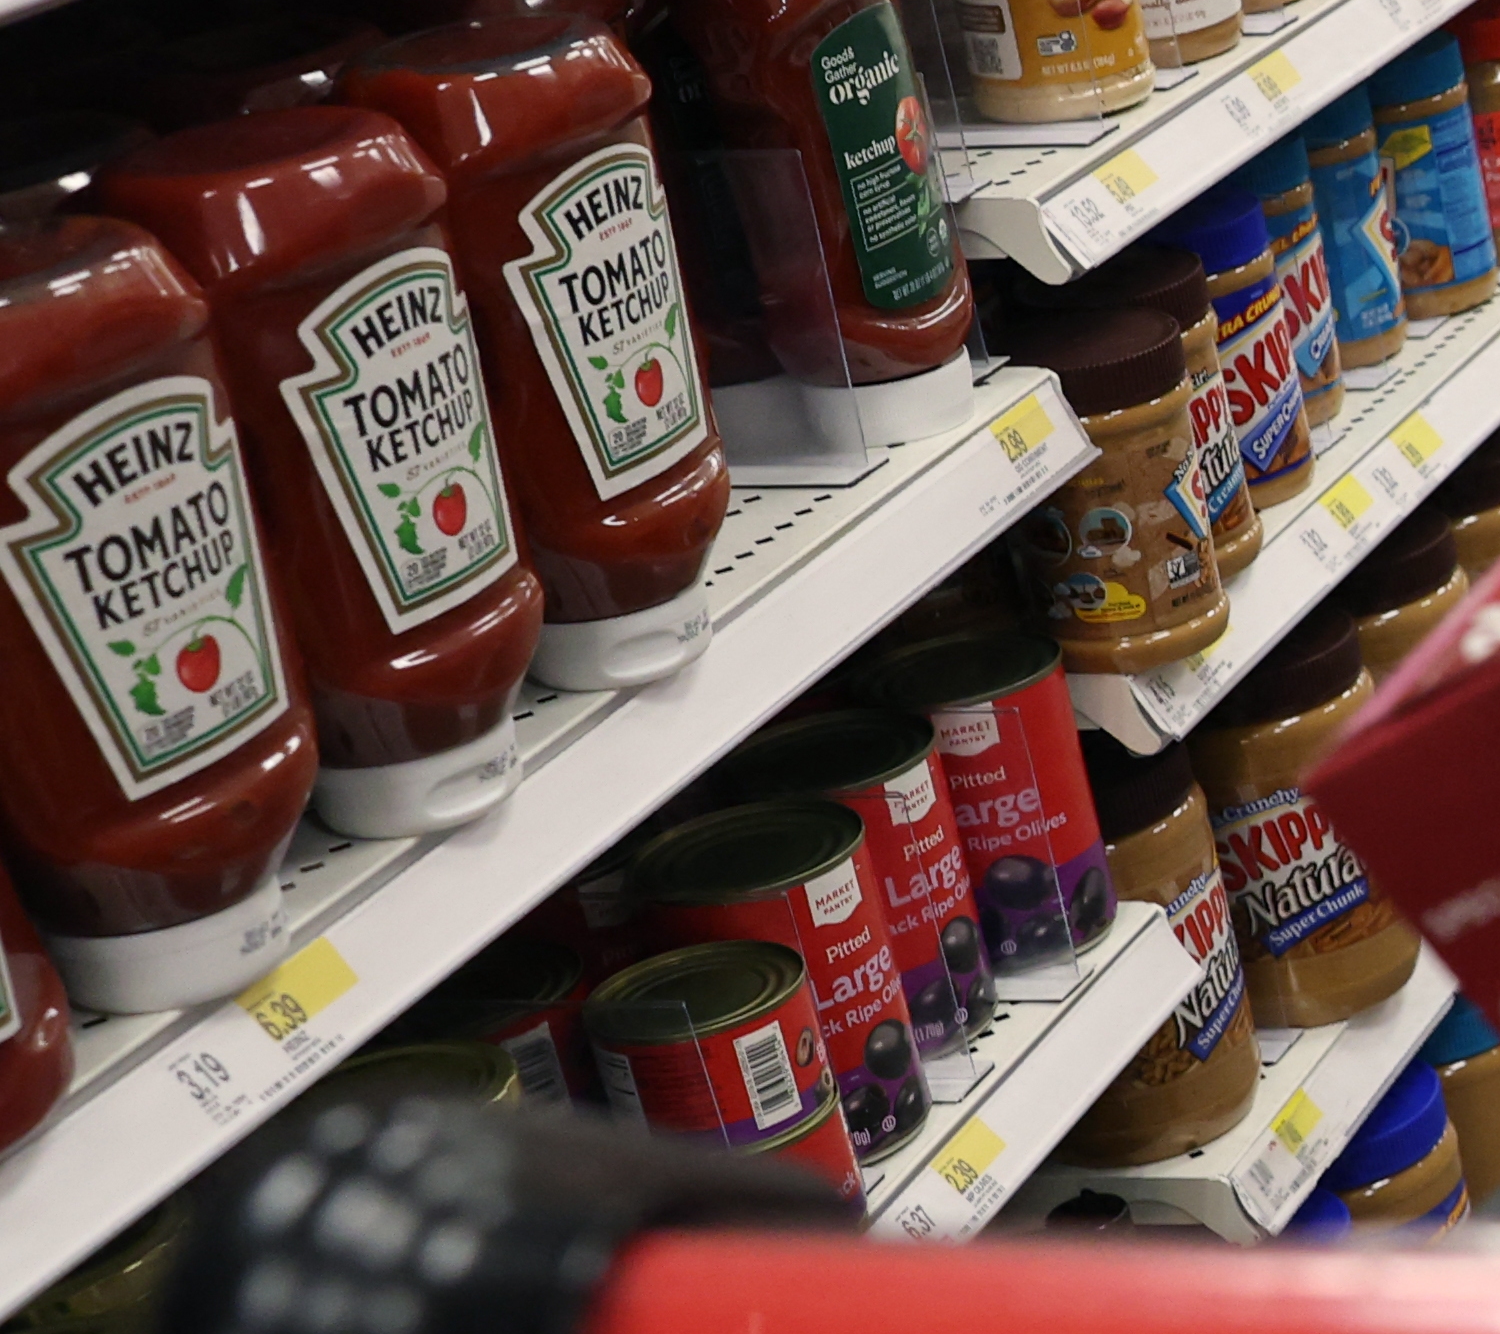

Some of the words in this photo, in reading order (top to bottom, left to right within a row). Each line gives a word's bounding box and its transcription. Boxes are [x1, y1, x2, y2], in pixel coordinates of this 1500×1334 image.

[821, 45, 855, 70] Good&
[824, 63, 858, 84] Gather
[829, 50, 900, 106] organic
[843, 135, 896, 170] ketchup
[565, 174, 645, 239] HEINZ
[558, 229, 667, 317] TOMATO
[350, 283, 444, 356] HEINZ
[577, 269, 671, 348] KETCHUP
[343, 345, 471, 440] TOMATO
[364, 390, 476, 474] KETCHUP
[1252, 418, 1283, 459] SUPER
[73, 421, 194, 507] HEINZ
[63, 480, 229, 593] TOMATO
[91, 530, 234, 630] KETCHUP
[941, 719, 991, 741] MARKET
[950, 765, 1006, 790] Pitted
[904, 826, 945, 861] Pitted
[968, 831, 1012, 852] Ripe
[1015, 811, 1067, 840] Olives
[815, 878, 855, 910] MARKET
[884, 844, 962, 909] Large
[823, 895, 854, 918] PANTRY
[922, 895, 954, 925] Ripe
[1270, 910, 1315, 946] Super
[1316, 886, 1365, 921] Chunk
[826, 925, 871, 965] Pitted
[815, 945, 892, 1012] Large
[259, 991, 309, 1041] 6.39
[846, 997, 883, 1029] Ripe
[1197, 1011, 1231, 1050] Super
[177, 1052, 231, 1101] 3.19
[944, 1158, 980, 1201] 2.39
